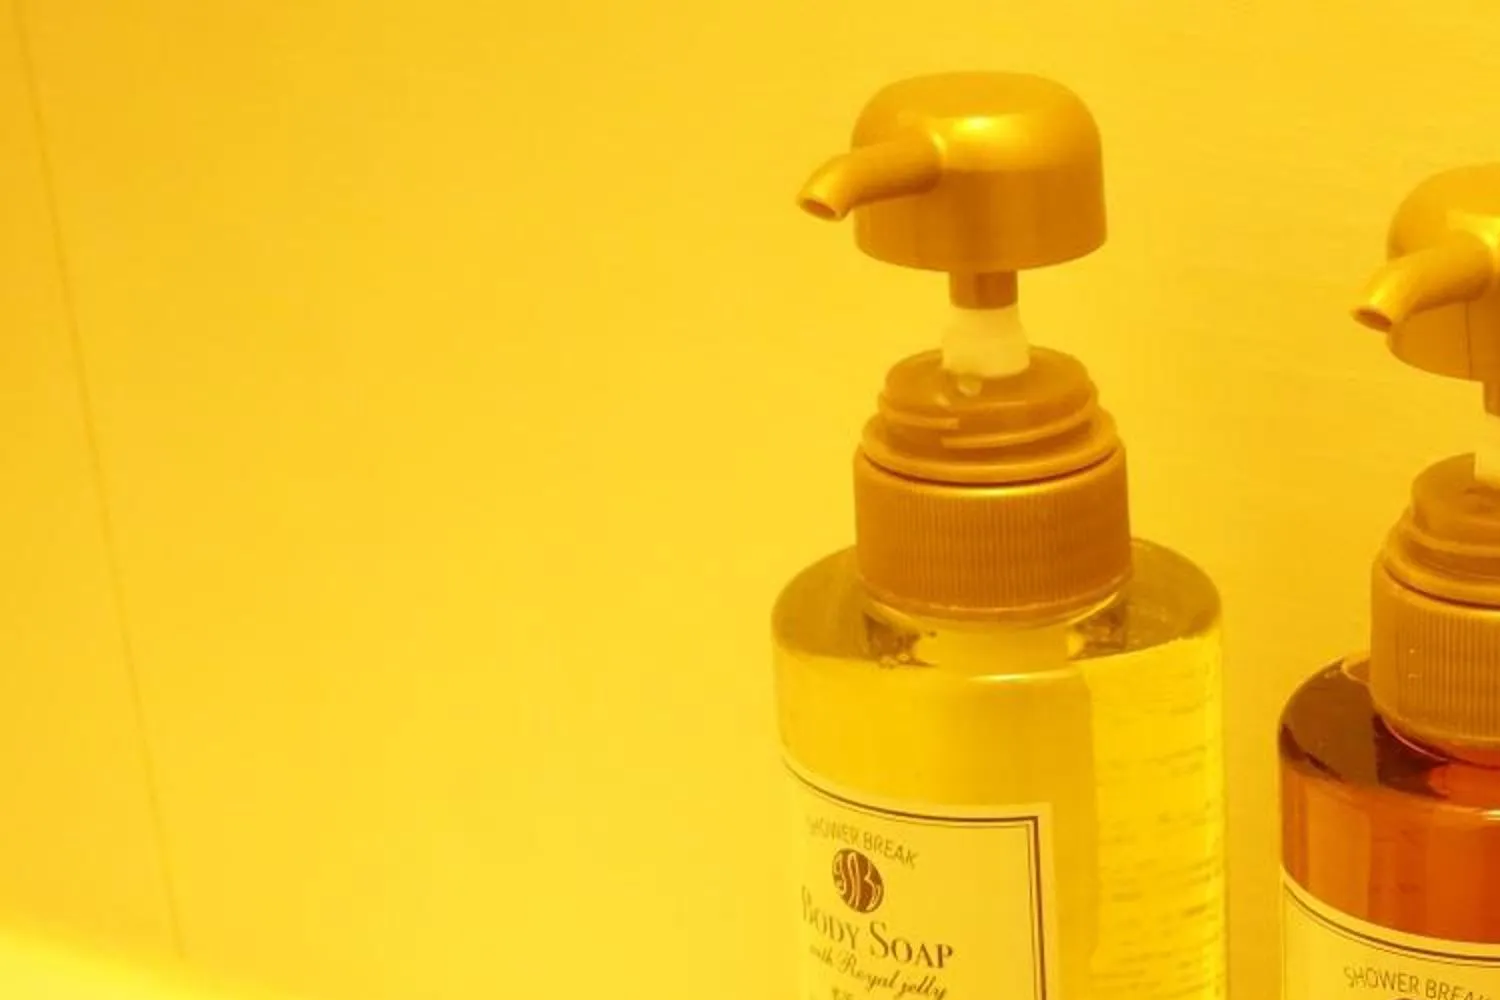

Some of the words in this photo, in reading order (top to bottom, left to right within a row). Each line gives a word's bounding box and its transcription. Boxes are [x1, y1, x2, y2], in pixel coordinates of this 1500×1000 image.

[863, 831, 919, 870] BREAK
[801, 884, 860, 950] BODY
[869, 920, 954, 969] SOAP
[837, 950, 901, 993] Royal
[1343, 965, 1420, 994] SHOWER
